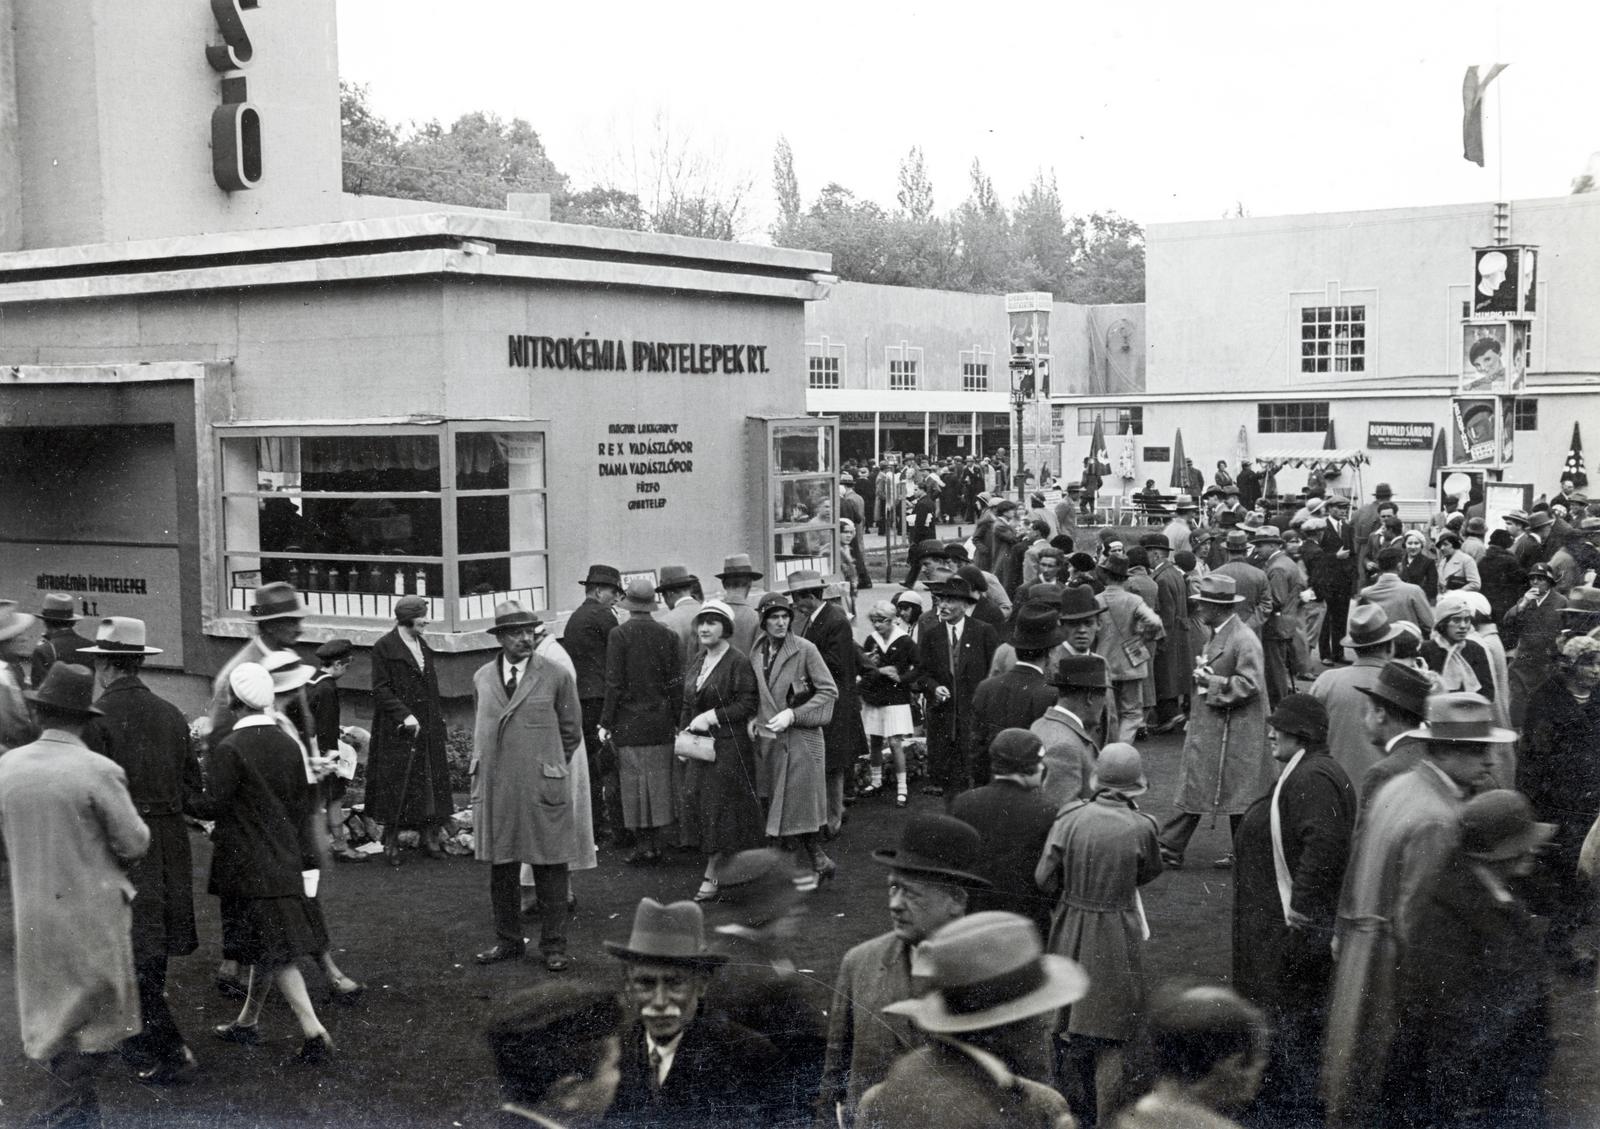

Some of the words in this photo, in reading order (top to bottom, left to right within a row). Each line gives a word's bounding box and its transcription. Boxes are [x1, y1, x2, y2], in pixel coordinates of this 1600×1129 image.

[508, 332, 627, 371] NITROKÉMIA
[632, 340, 745, 374] IPARTELEPEK
[747, 344, 770, 373] RT.
[598, 462, 628, 476] DIANA
